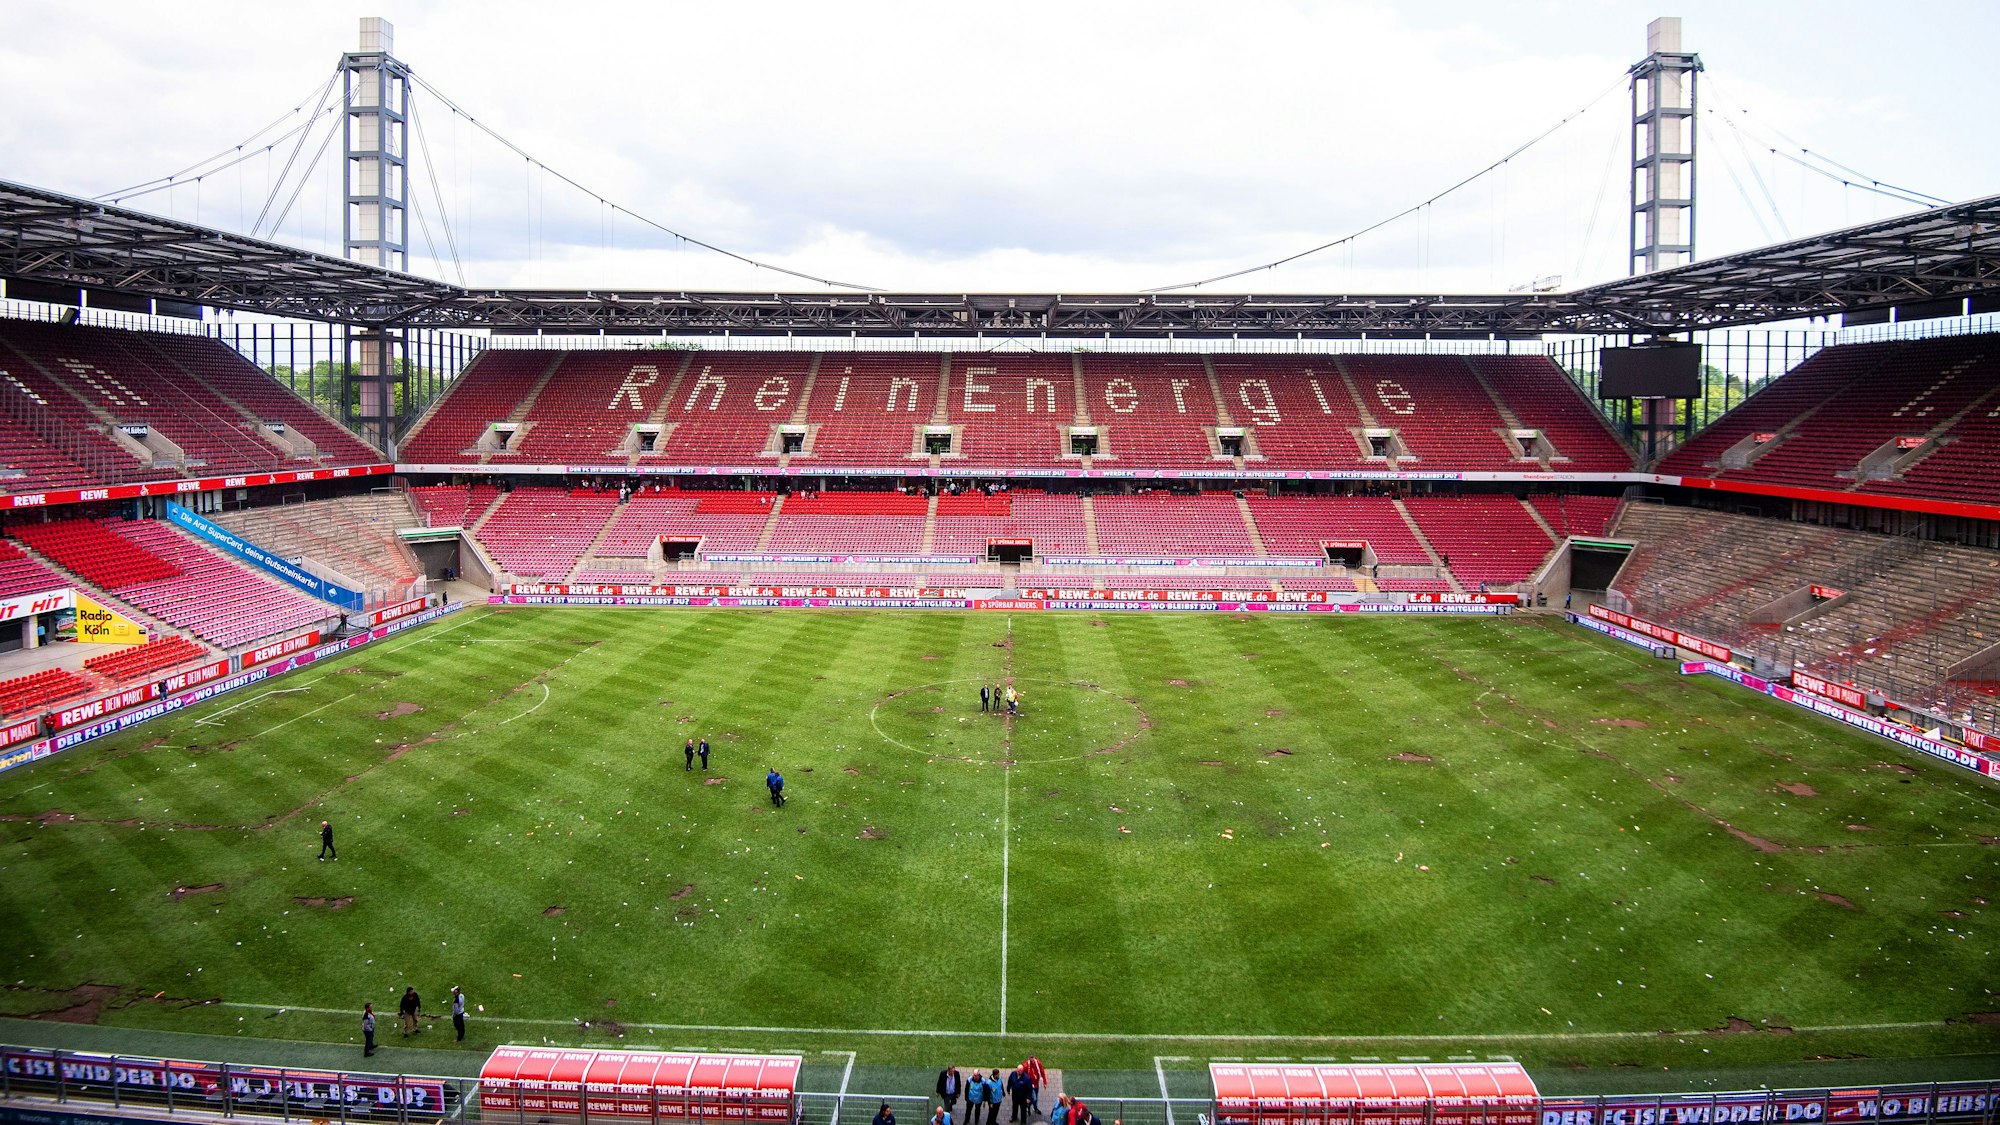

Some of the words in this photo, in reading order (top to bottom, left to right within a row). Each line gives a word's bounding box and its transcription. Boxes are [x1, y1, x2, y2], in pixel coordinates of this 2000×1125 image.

[296, 472, 315, 480] REWE
[333, 469, 350, 477] REWE
[177, 481, 200, 491] REWE
[225, 477, 246, 487] REWE
[14, 494, 46, 506] REWE
[80, 489, 109, 501] REWE
[180, 512, 192, 524] Die
[193, 520, 207, 531] Aral
[208, 526, 244, 552] SuperCard,
[245, 547, 264, 561] deine
[265, 556, 318, 589] Gutscheinkarte!
[516, 585, 560, 594] REWE.de
[568, 586, 613, 595] REWE.de
[622, 586, 666, 595] REWE.de
[675, 586, 720, 596] REWE.de
[728, 587, 774, 596] REWE.de
[782, 587, 827, 597] REWE.de
[836, 588, 881, 598] REWE.de
[1059, 590, 1104, 600] REWE.de
[1113, 590, 1158, 600] REWE.de
[1167, 591, 1213, 601] REWE.de
[1222, 591, 1268, 601] REWE.de
[1276, 591, 1322, 602] REWE.de
[1440, 593, 1487, 603] REWE.de
[31, 596, 65, 613] HIT
[988, 600, 1014, 609] SPÜRBAR
[1015, 600, 1038, 609] ANDERS.
[1359, 604, 1378, 612] ALLE
[1379, 604, 1403, 612] INFOS
[1405, 604, 1432, 612] UNTER
[80, 610, 112, 621] Radio
[381, 606, 402, 621] REWE
[84, 624, 110, 635] Köln
[314, 643, 340, 659] WERDE
[340, 639, 349, 649] FC
[1704, 662, 1732, 680] WERDE
[1733, 671, 1743, 682] FC
[151, 676, 185, 697] RWE
[57, 735, 82, 749] DER
[85, 727, 98, 738] FC
[100, 720, 118, 735] IST
[120, 702, 164, 727] WIDDER
[167, 698, 182, 711] DO
[195, 687, 212, 700] WO
[214, 676, 249, 695] BLEIBST
[250, 668, 268, 681] DU?
[61, 701, 104, 727] REWE
[105, 696, 121, 713] DEIN
[122, 688, 144, 708] MARKT
[10, 721, 37, 743] MARKT
[1792, 693, 1814, 709] ALLE
[1814, 701, 1844, 719] INFOS
[1846, 712, 1881, 733] UNTER
[1882, 726, 1978, 769] FC-MITGLIED.DE
[497, 1050, 526, 1058] REWE
[530, 1051, 559, 1059] REWE
[563, 1053, 591, 1061] REWE
[598, 1054, 626, 1062] REWE
[631, 1055, 659, 1063] REWE
[664, 1056, 693, 1065] REWE
[700, 1058, 728, 1066] REWE
[733, 1059, 761, 1067] REWE
[768, 1059, 795, 1068] REWE
[1216, 1068, 1244, 1076] REWE
[1251, 1068, 1279, 1076] REWE
[1285, 1068, 1313, 1077] REWE
[1321, 1068, 1349, 1076] REWE
[1355, 1068, 1383, 1076] REWE
[1388, 1068, 1417, 1076] REWE
[1424, 1068, 1453, 1076] REWE
[1492, 1067, 1521, 1075] REWE
[484, 1077, 511, 1088] REWE
[551, 1081, 578, 1091] REWE
[587, 1082, 614, 1092] REWE
[621, 1084, 648, 1094] REWE
[761, 1088, 789, 1098] REWE
[485, 1097, 511, 1106] REWE
[552, 1101, 579, 1109] REWE
[1221, 1097, 1250, 1107] REWE
[1364, 1096, 1393, 1106] REWE
[1435, 1096, 1464, 1106] REWE
[1505, 1095, 1533, 1105] REWE
[588, 1102, 614, 1111] REWE
[622, 1103, 649, 1112] REWE
[762, 1108, 788, 1117] REWE
[1542, 1110, 1593, 1125] DER
[1786, 1102, 1822, 1120] DO
[1858, 1100, 1900, 1117] WO
